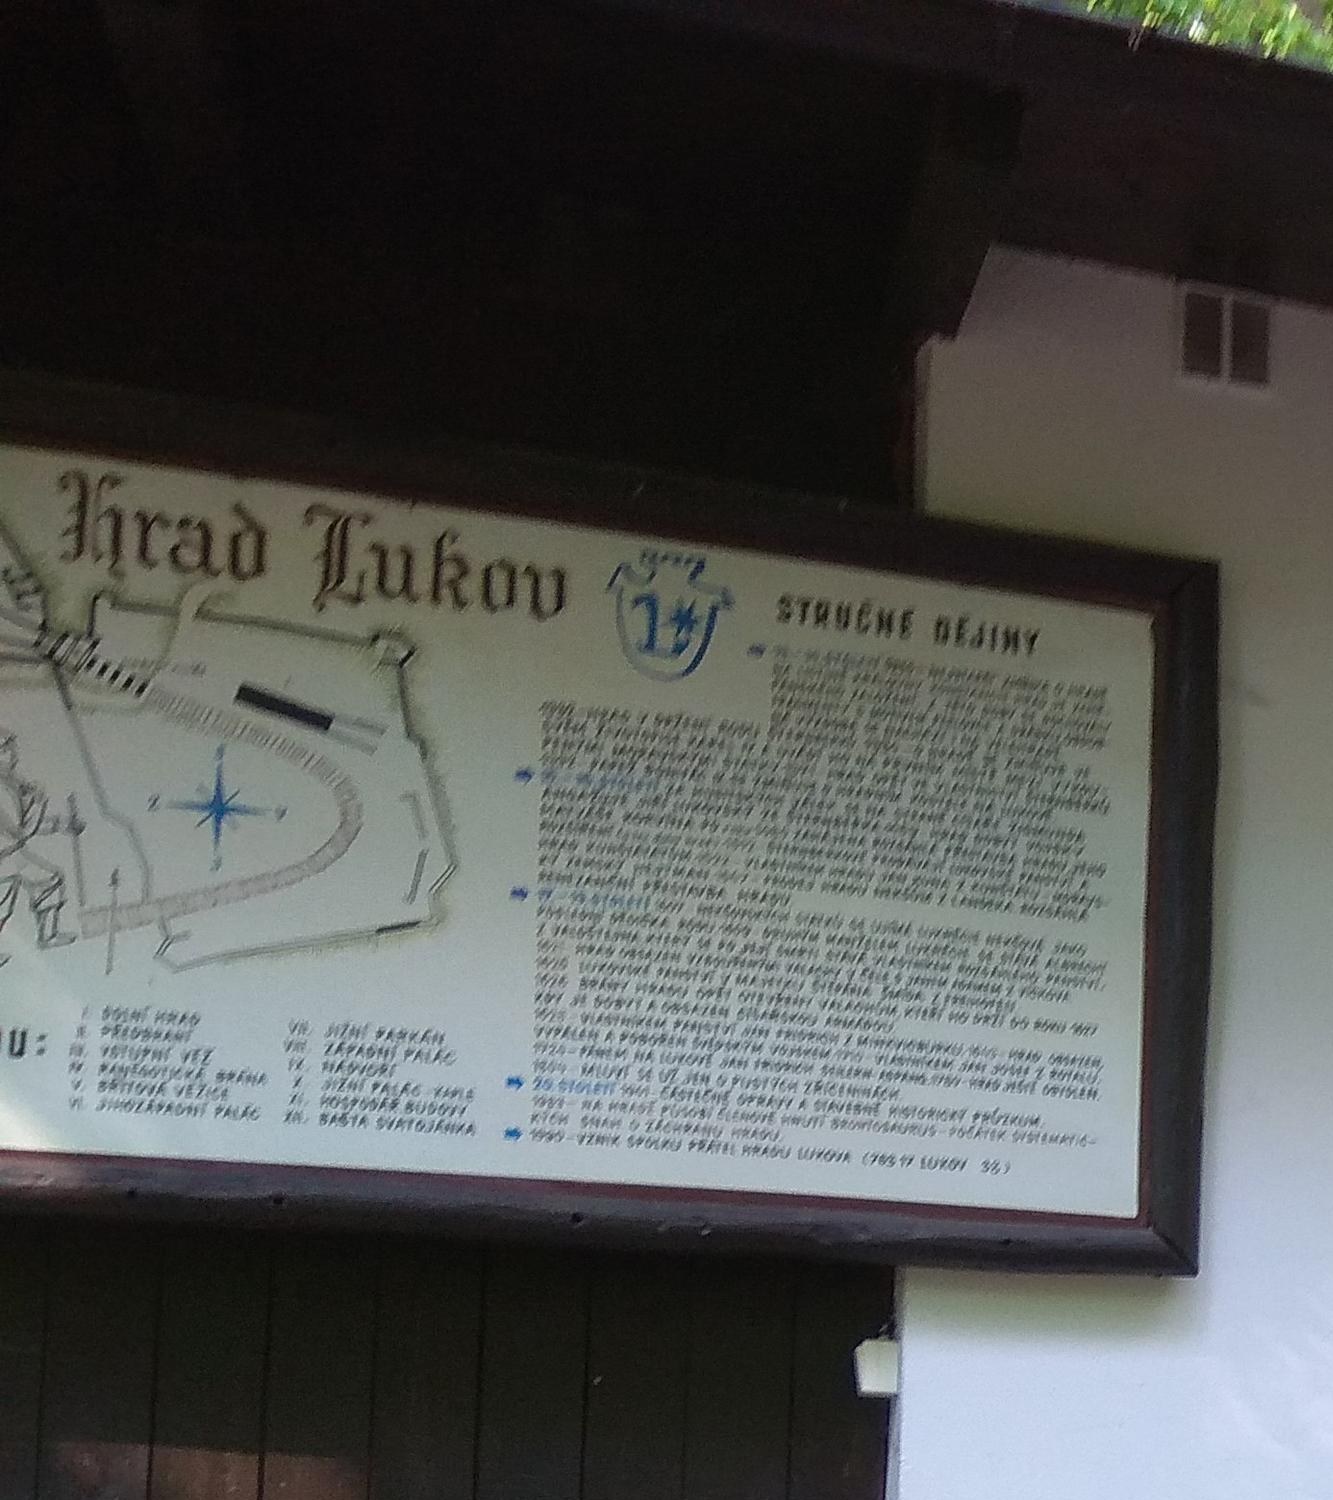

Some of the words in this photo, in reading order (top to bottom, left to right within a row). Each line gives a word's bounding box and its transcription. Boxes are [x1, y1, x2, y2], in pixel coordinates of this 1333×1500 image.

[57, 470, 269, 581] Hrad
[305, 501, 568, 622] Lukov
[934, 612, 1041, 656] DĚJINY
